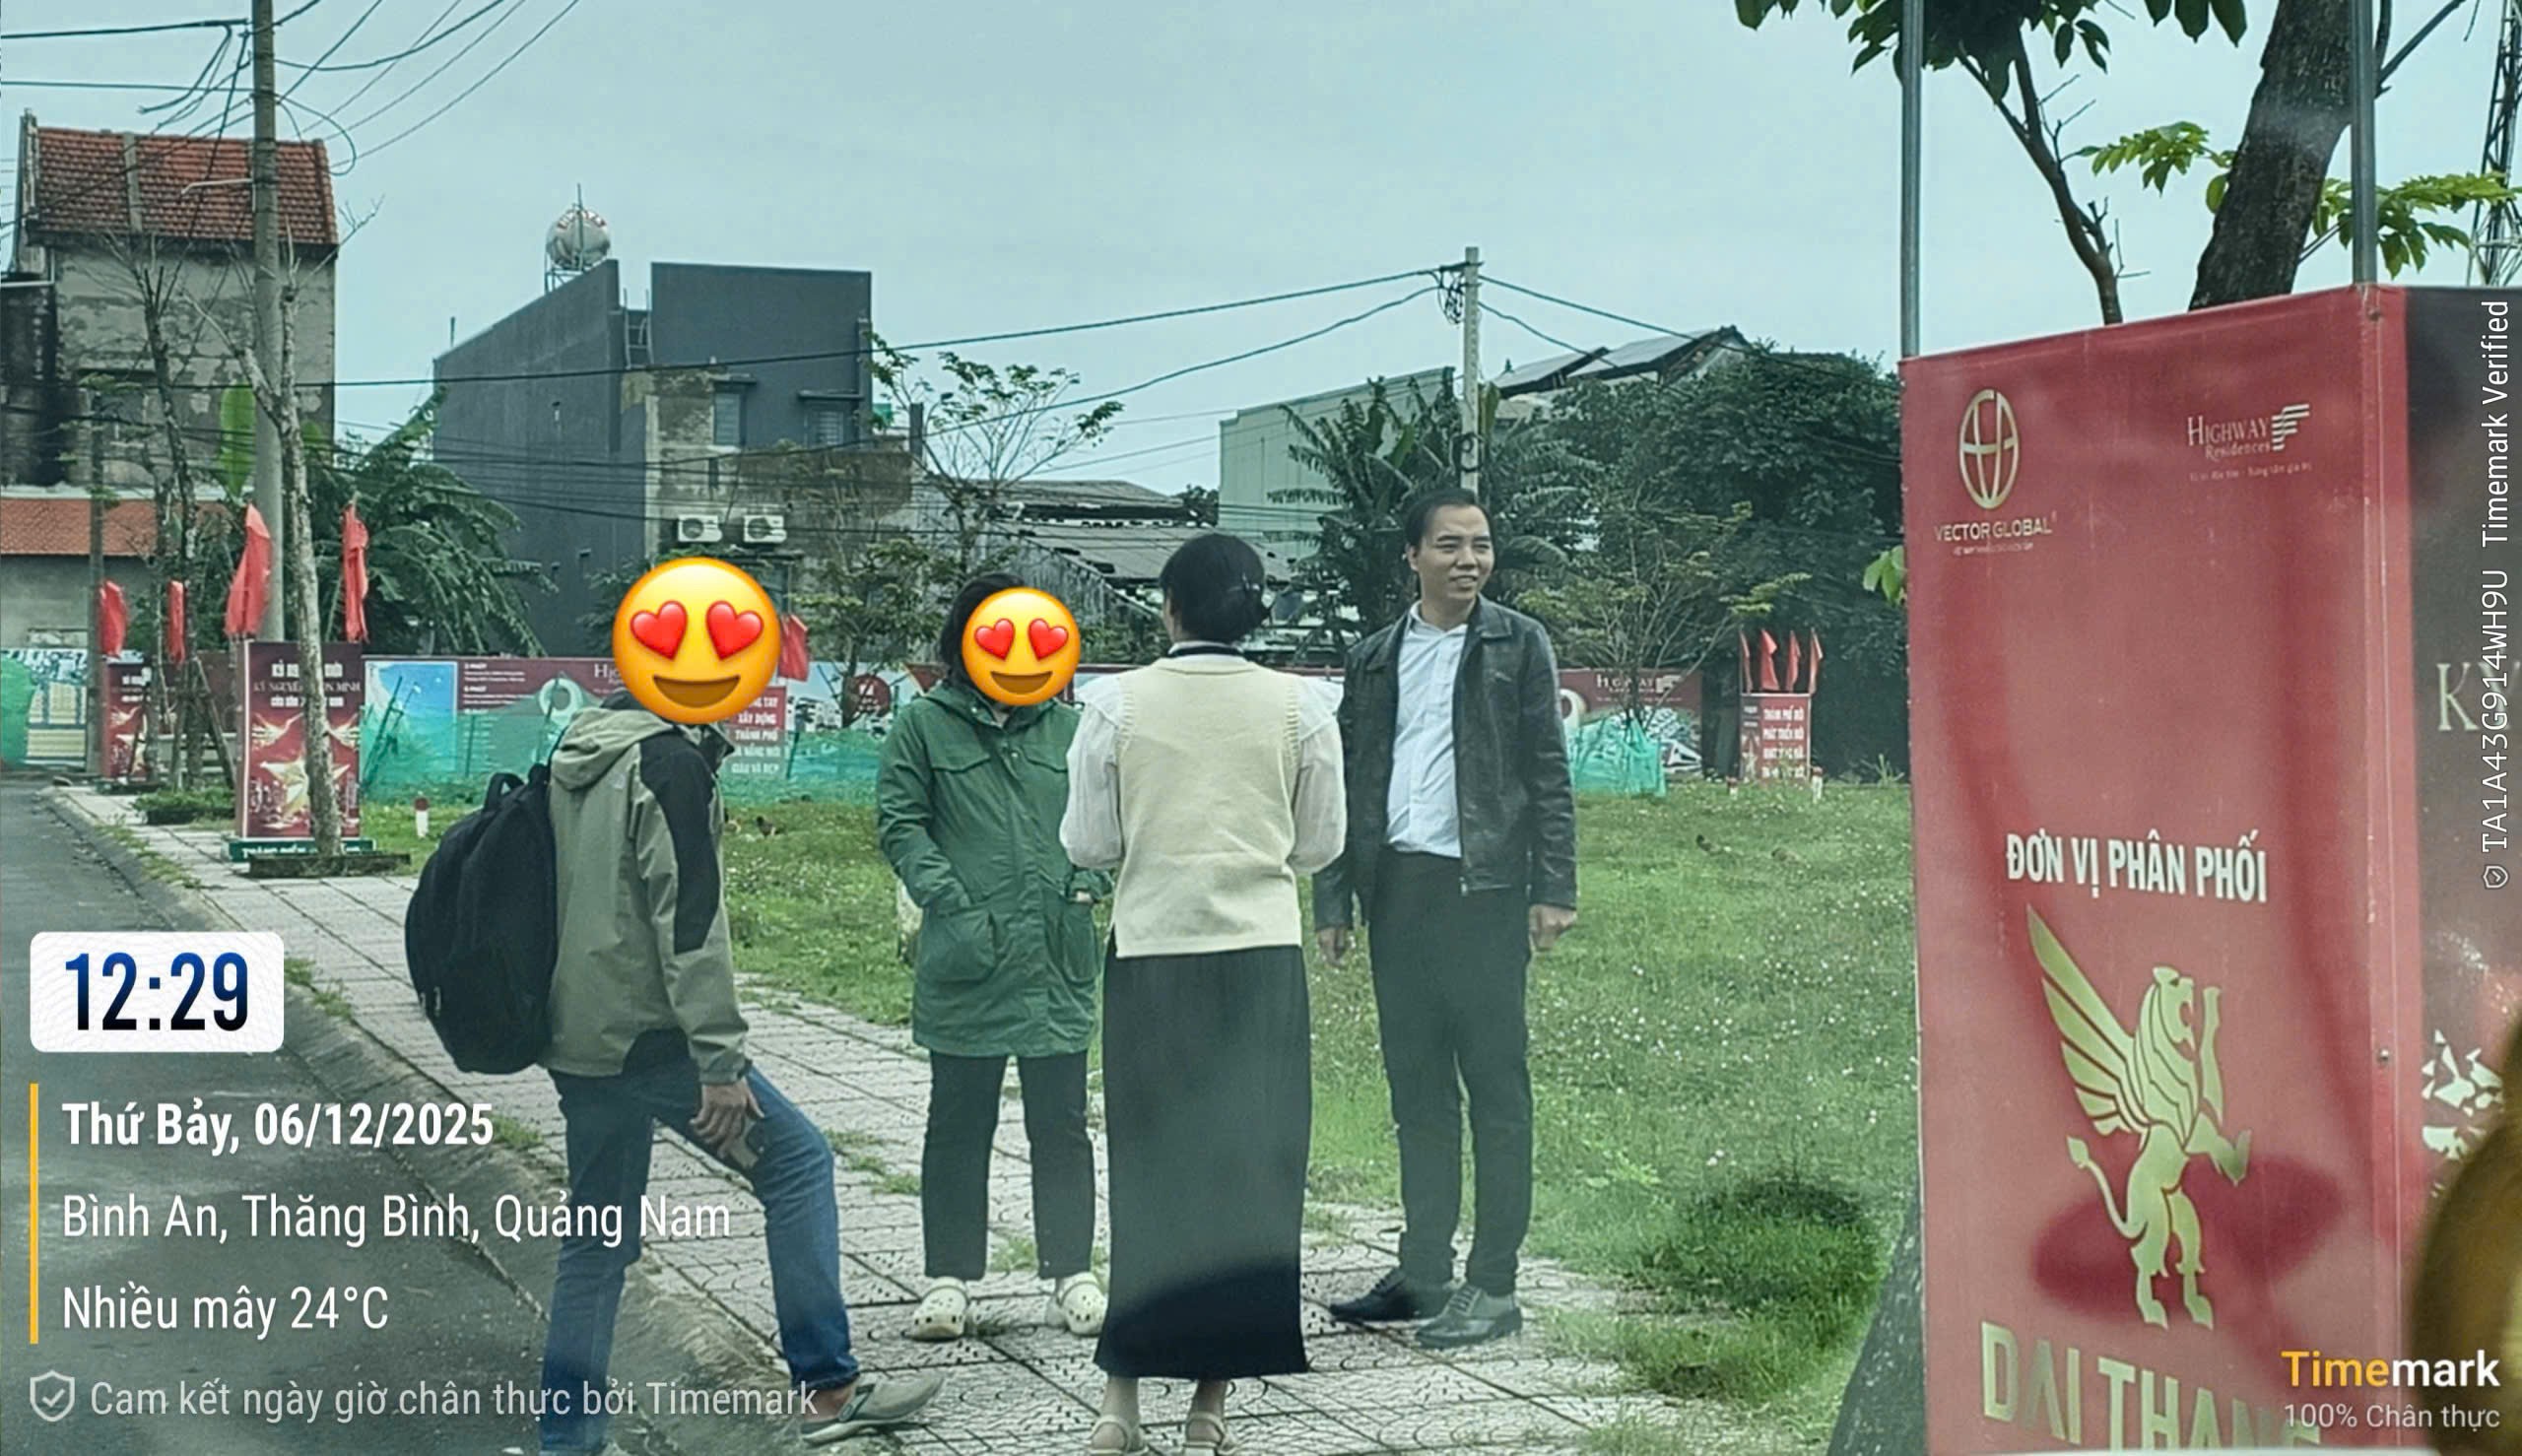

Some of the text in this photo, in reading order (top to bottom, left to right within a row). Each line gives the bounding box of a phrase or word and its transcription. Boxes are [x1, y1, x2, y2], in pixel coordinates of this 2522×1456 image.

[2187, 415, 2268, 446] HIGHWAY
[1934, 516, 2052, 542] VECTOR GLOBAL
[2006, 827, 2266, 903] ĐƠN VỊ PHÂN PHỐI
